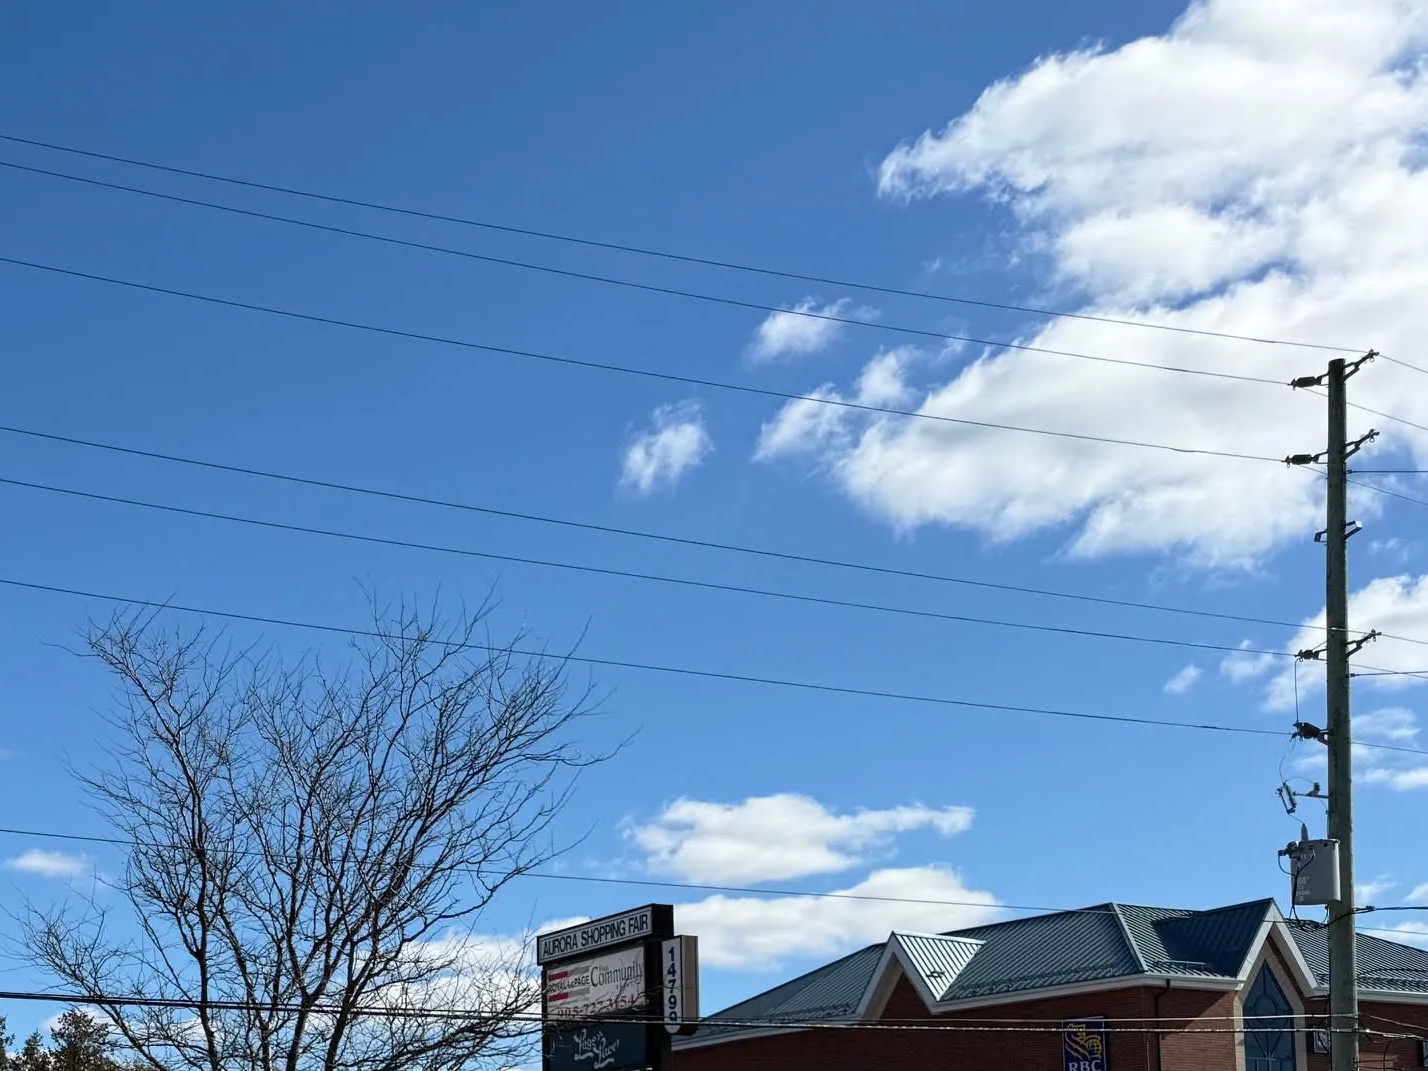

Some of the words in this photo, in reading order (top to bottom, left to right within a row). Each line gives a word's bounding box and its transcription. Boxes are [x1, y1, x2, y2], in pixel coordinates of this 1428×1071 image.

[543, 934, 578, 957] AURORA
[581, 920, 626, 947] SHOPPING
[628, 914, 648, 934] FAIR
[591, 961, 643, 987] Community
[667, 947, 678, 1022] 14799
